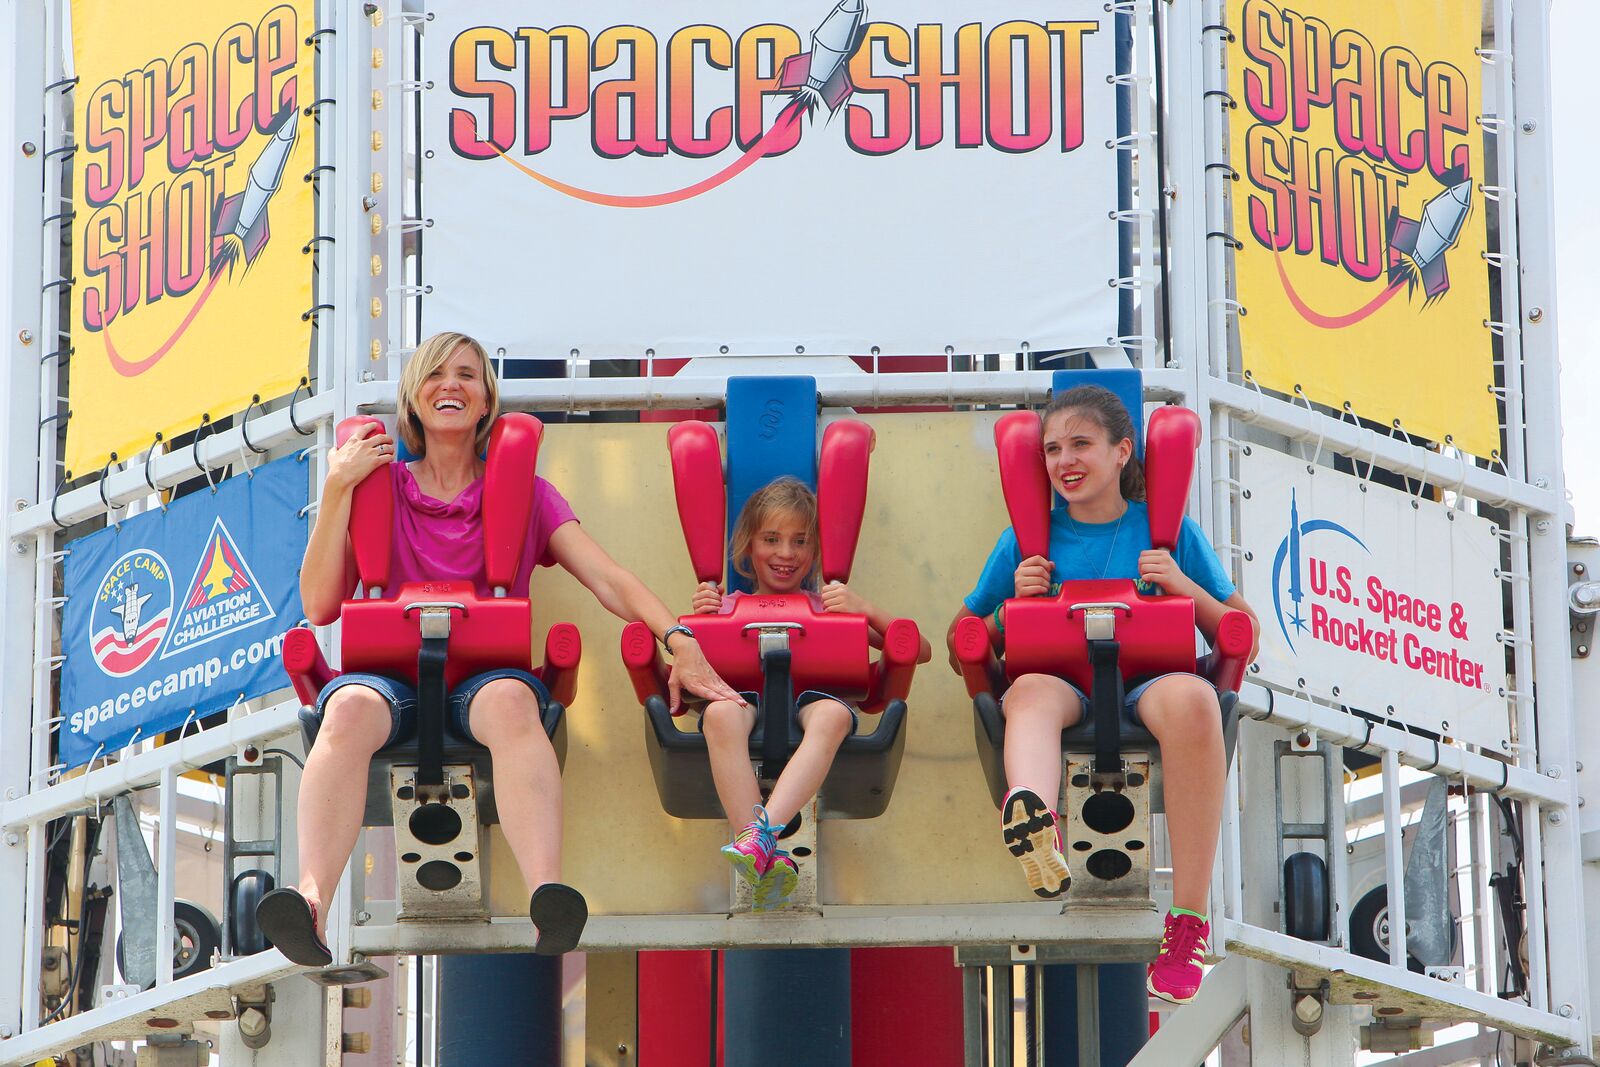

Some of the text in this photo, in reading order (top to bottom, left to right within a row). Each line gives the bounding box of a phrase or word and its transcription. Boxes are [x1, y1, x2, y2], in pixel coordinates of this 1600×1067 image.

[845, 20, 1099, 155] SHOT
[82, 151, 237, 332] SHOT
[1245, 123, 1409, 285] SHOT
[100, 556, 165, 603] SPACE CAMP
[182, 590, 252, 629] AVIATION
[1309, 557, 1470, 641] U.S. Space &
[173, 602, 260, 646] CHALLENGE
[1311, 603, 1398, 664] Rocket
[69, 632, 287, 735] spacecamp.com
